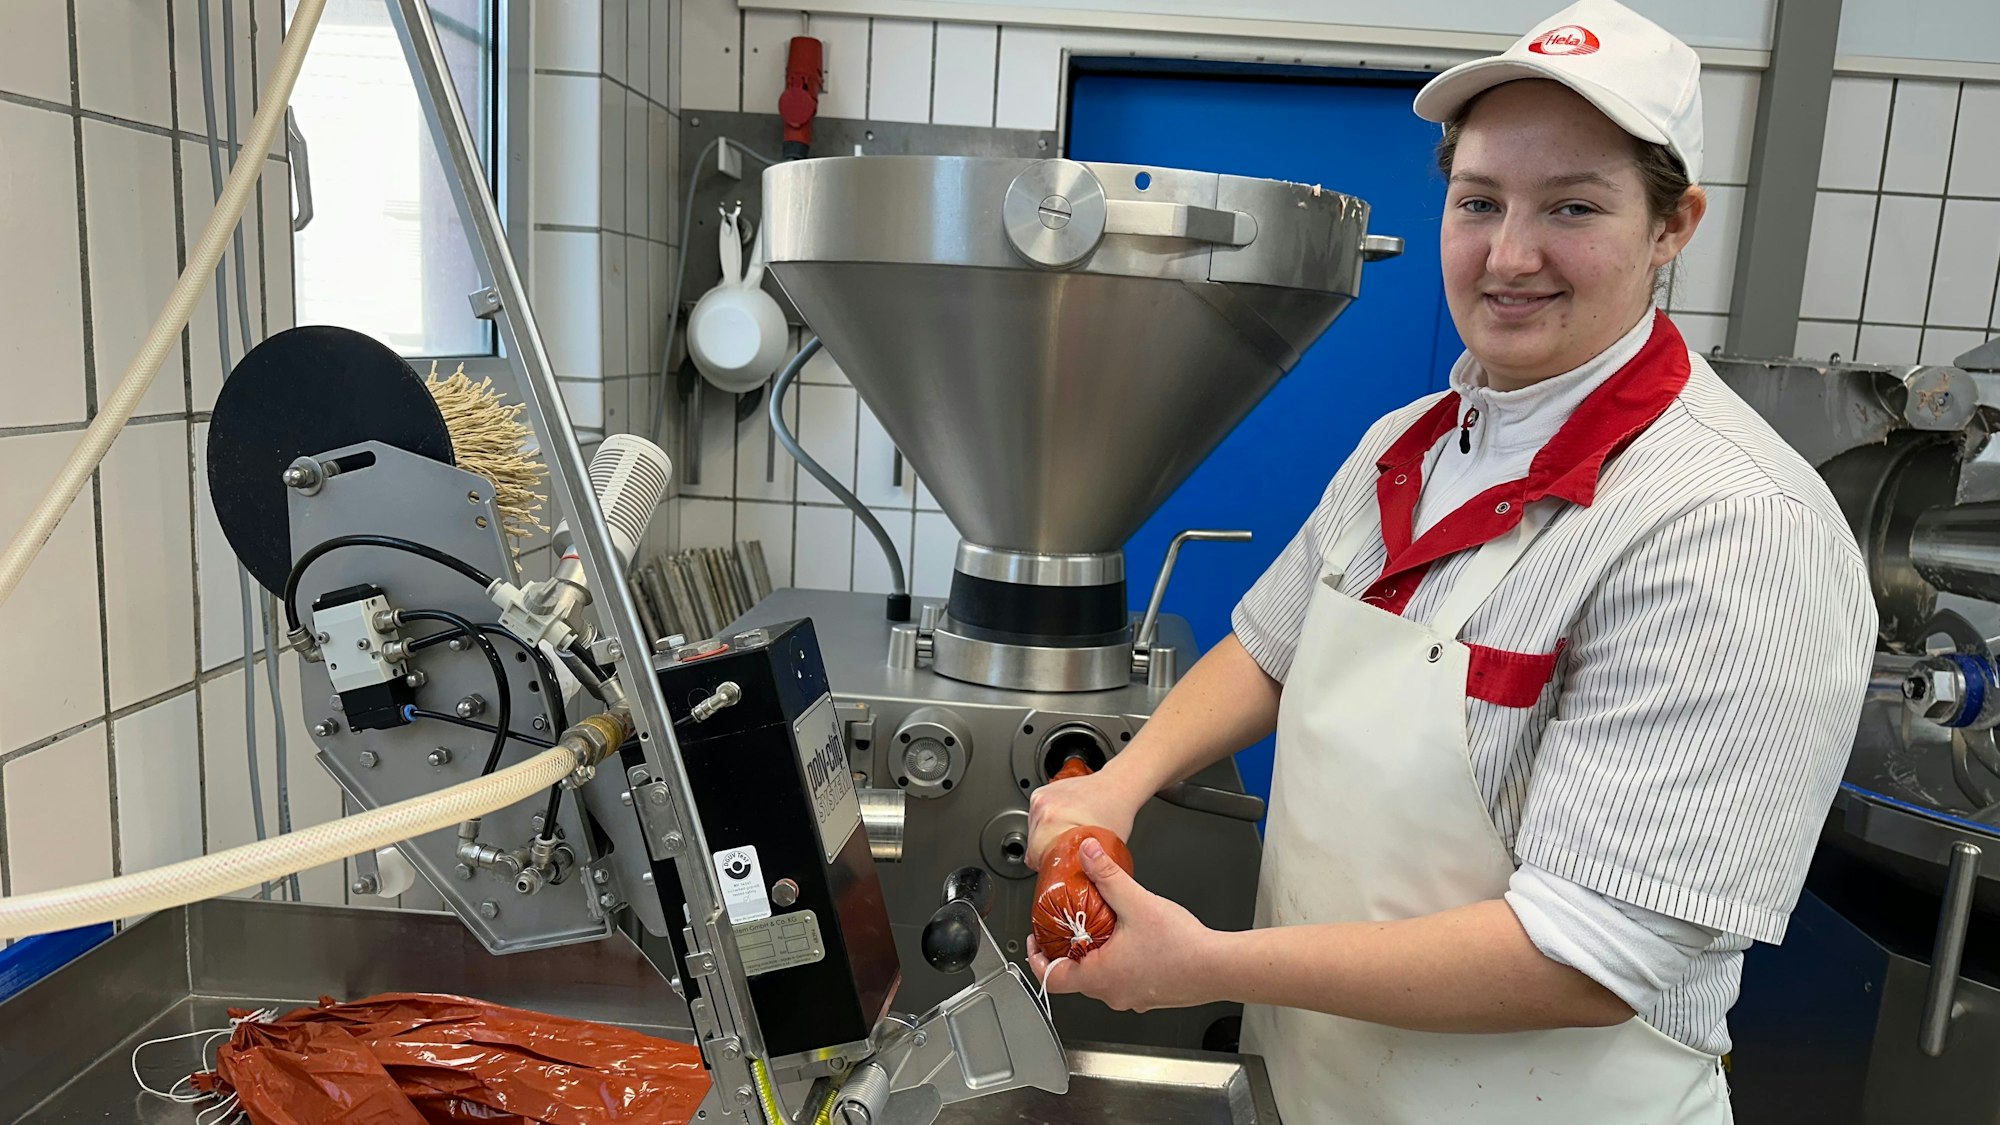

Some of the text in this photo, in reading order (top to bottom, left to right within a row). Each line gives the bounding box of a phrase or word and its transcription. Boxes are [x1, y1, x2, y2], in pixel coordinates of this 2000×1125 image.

[1545, 34, 1581, 46] Hela
[807, 734, 845, 800] poly-clip
[816, 769, 851, 824] SYSTEM
[724, 853, 749, 867] DGUV Test
[749, 922, 769, 931] GmbH
